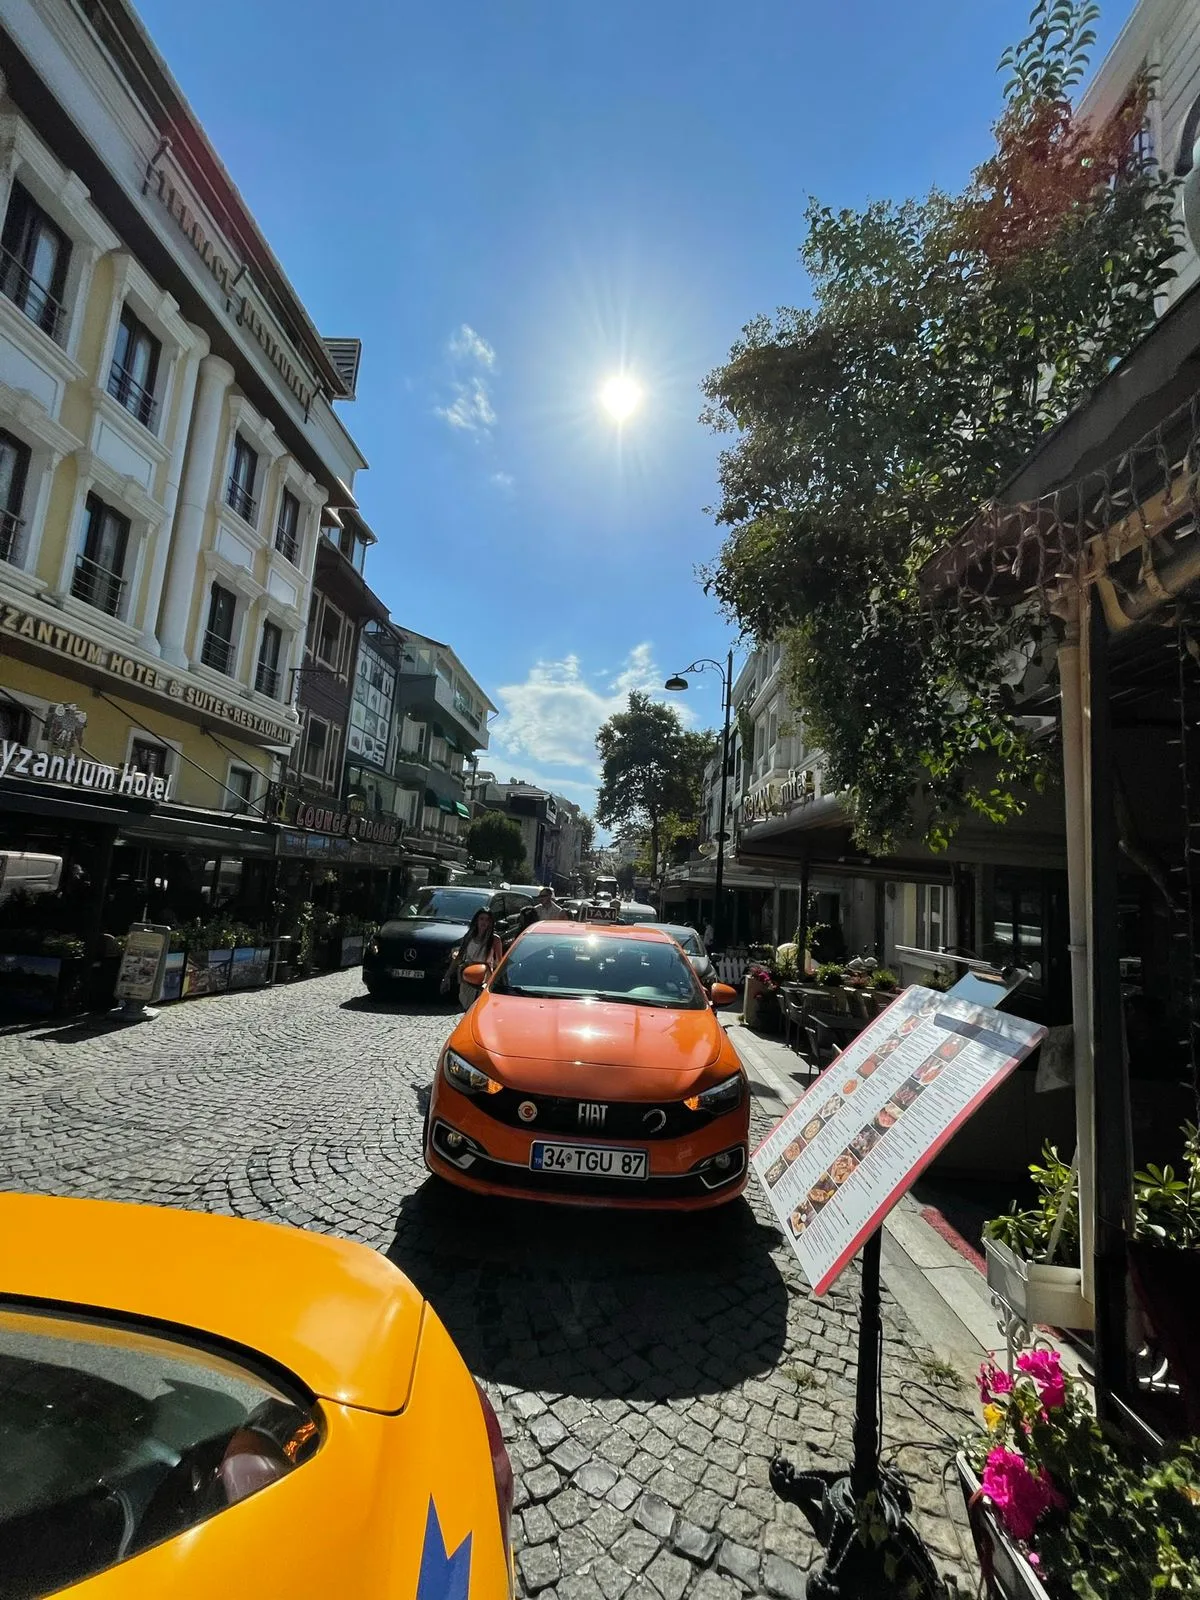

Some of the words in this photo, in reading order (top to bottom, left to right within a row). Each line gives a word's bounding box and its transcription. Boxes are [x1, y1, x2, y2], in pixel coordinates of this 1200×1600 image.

[0, 603, 103, 664] ZANTIUM
[110, 654, 162, 689] HOTEL
[186, 687, 229, 716] SUITES
[119, 763, 173, 802] Hotel
[296, 804, 348, 833] LOUNGE
[590, 909, 616, 919] TAXI
[578, 1102, 608, 1126] FIAT
[544, 1148, 566, 1169] 34
[574, 1150, 613, 1172] TGU
[621, 1154, 644, 1175] 87
